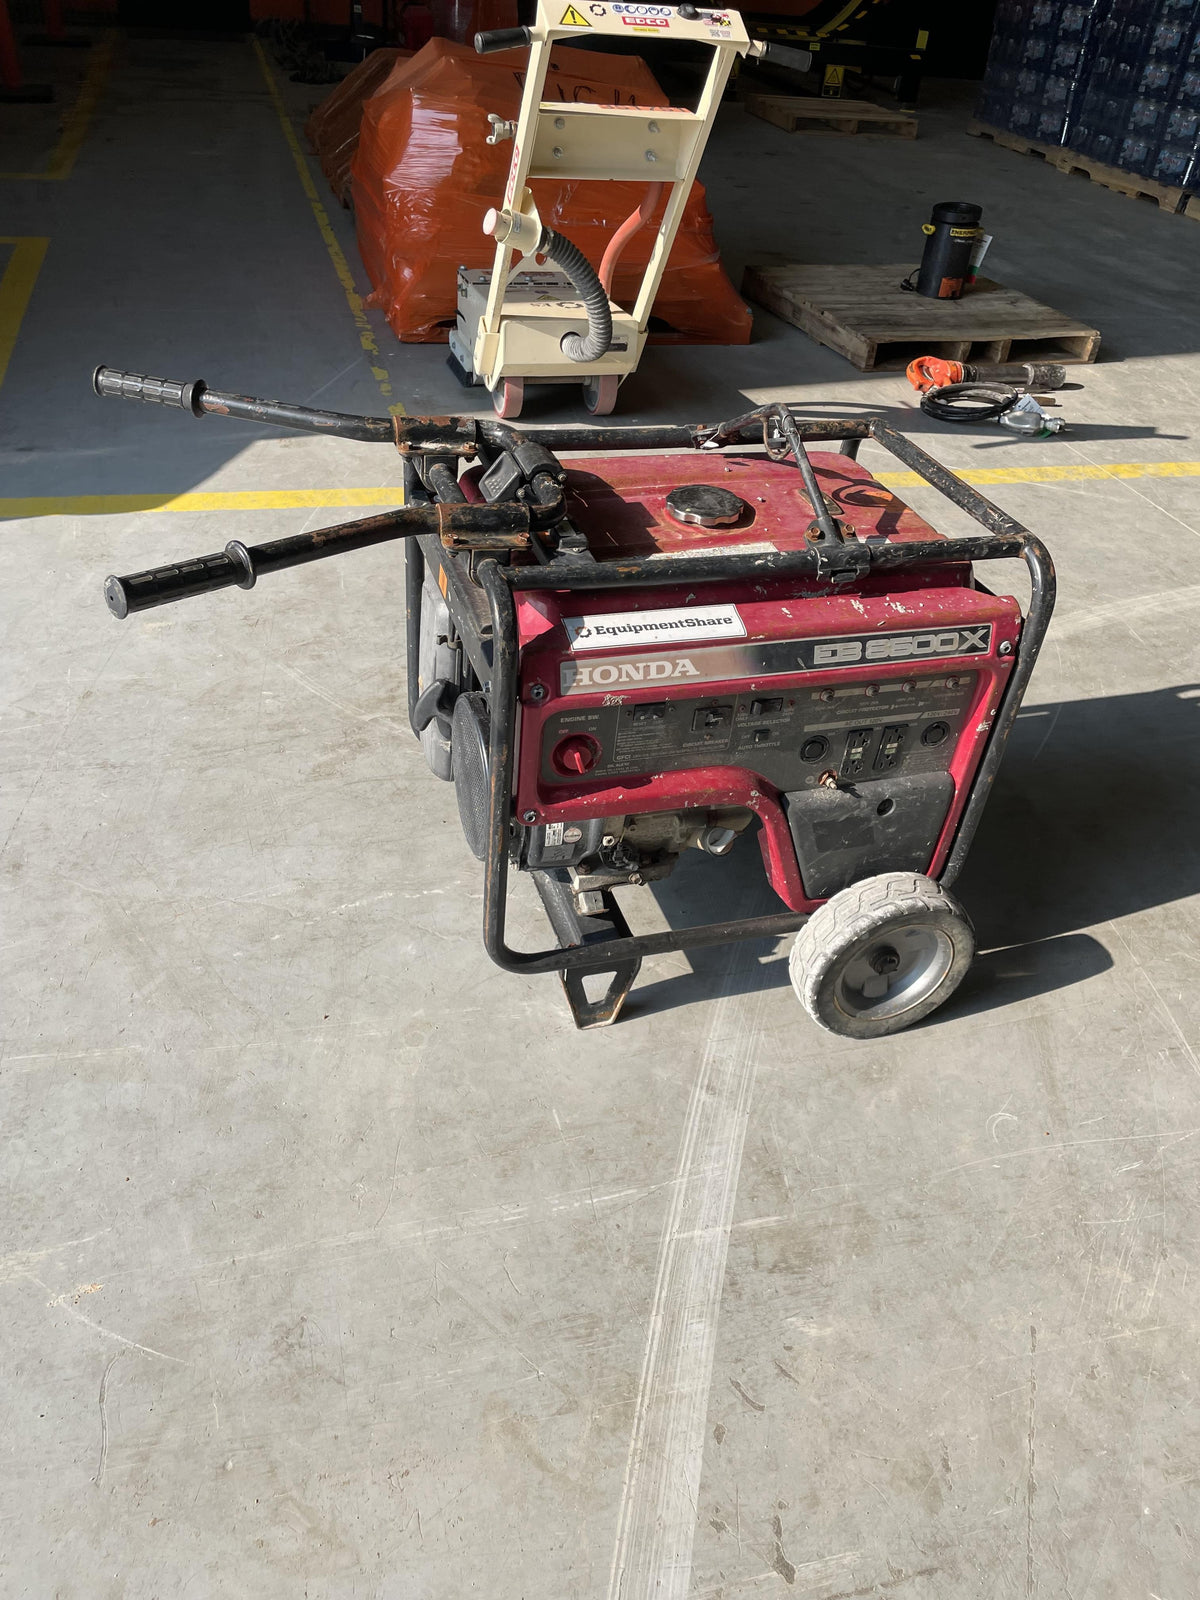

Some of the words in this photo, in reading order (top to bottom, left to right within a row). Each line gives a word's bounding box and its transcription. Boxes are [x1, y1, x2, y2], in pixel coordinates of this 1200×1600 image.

[625, 17, 667, 26] EDCO
[593, 615, 733, 637] EquipmentShare
[562, 658, 700, 687] HONDA
[560, 715, 586, 723] ENGINE
